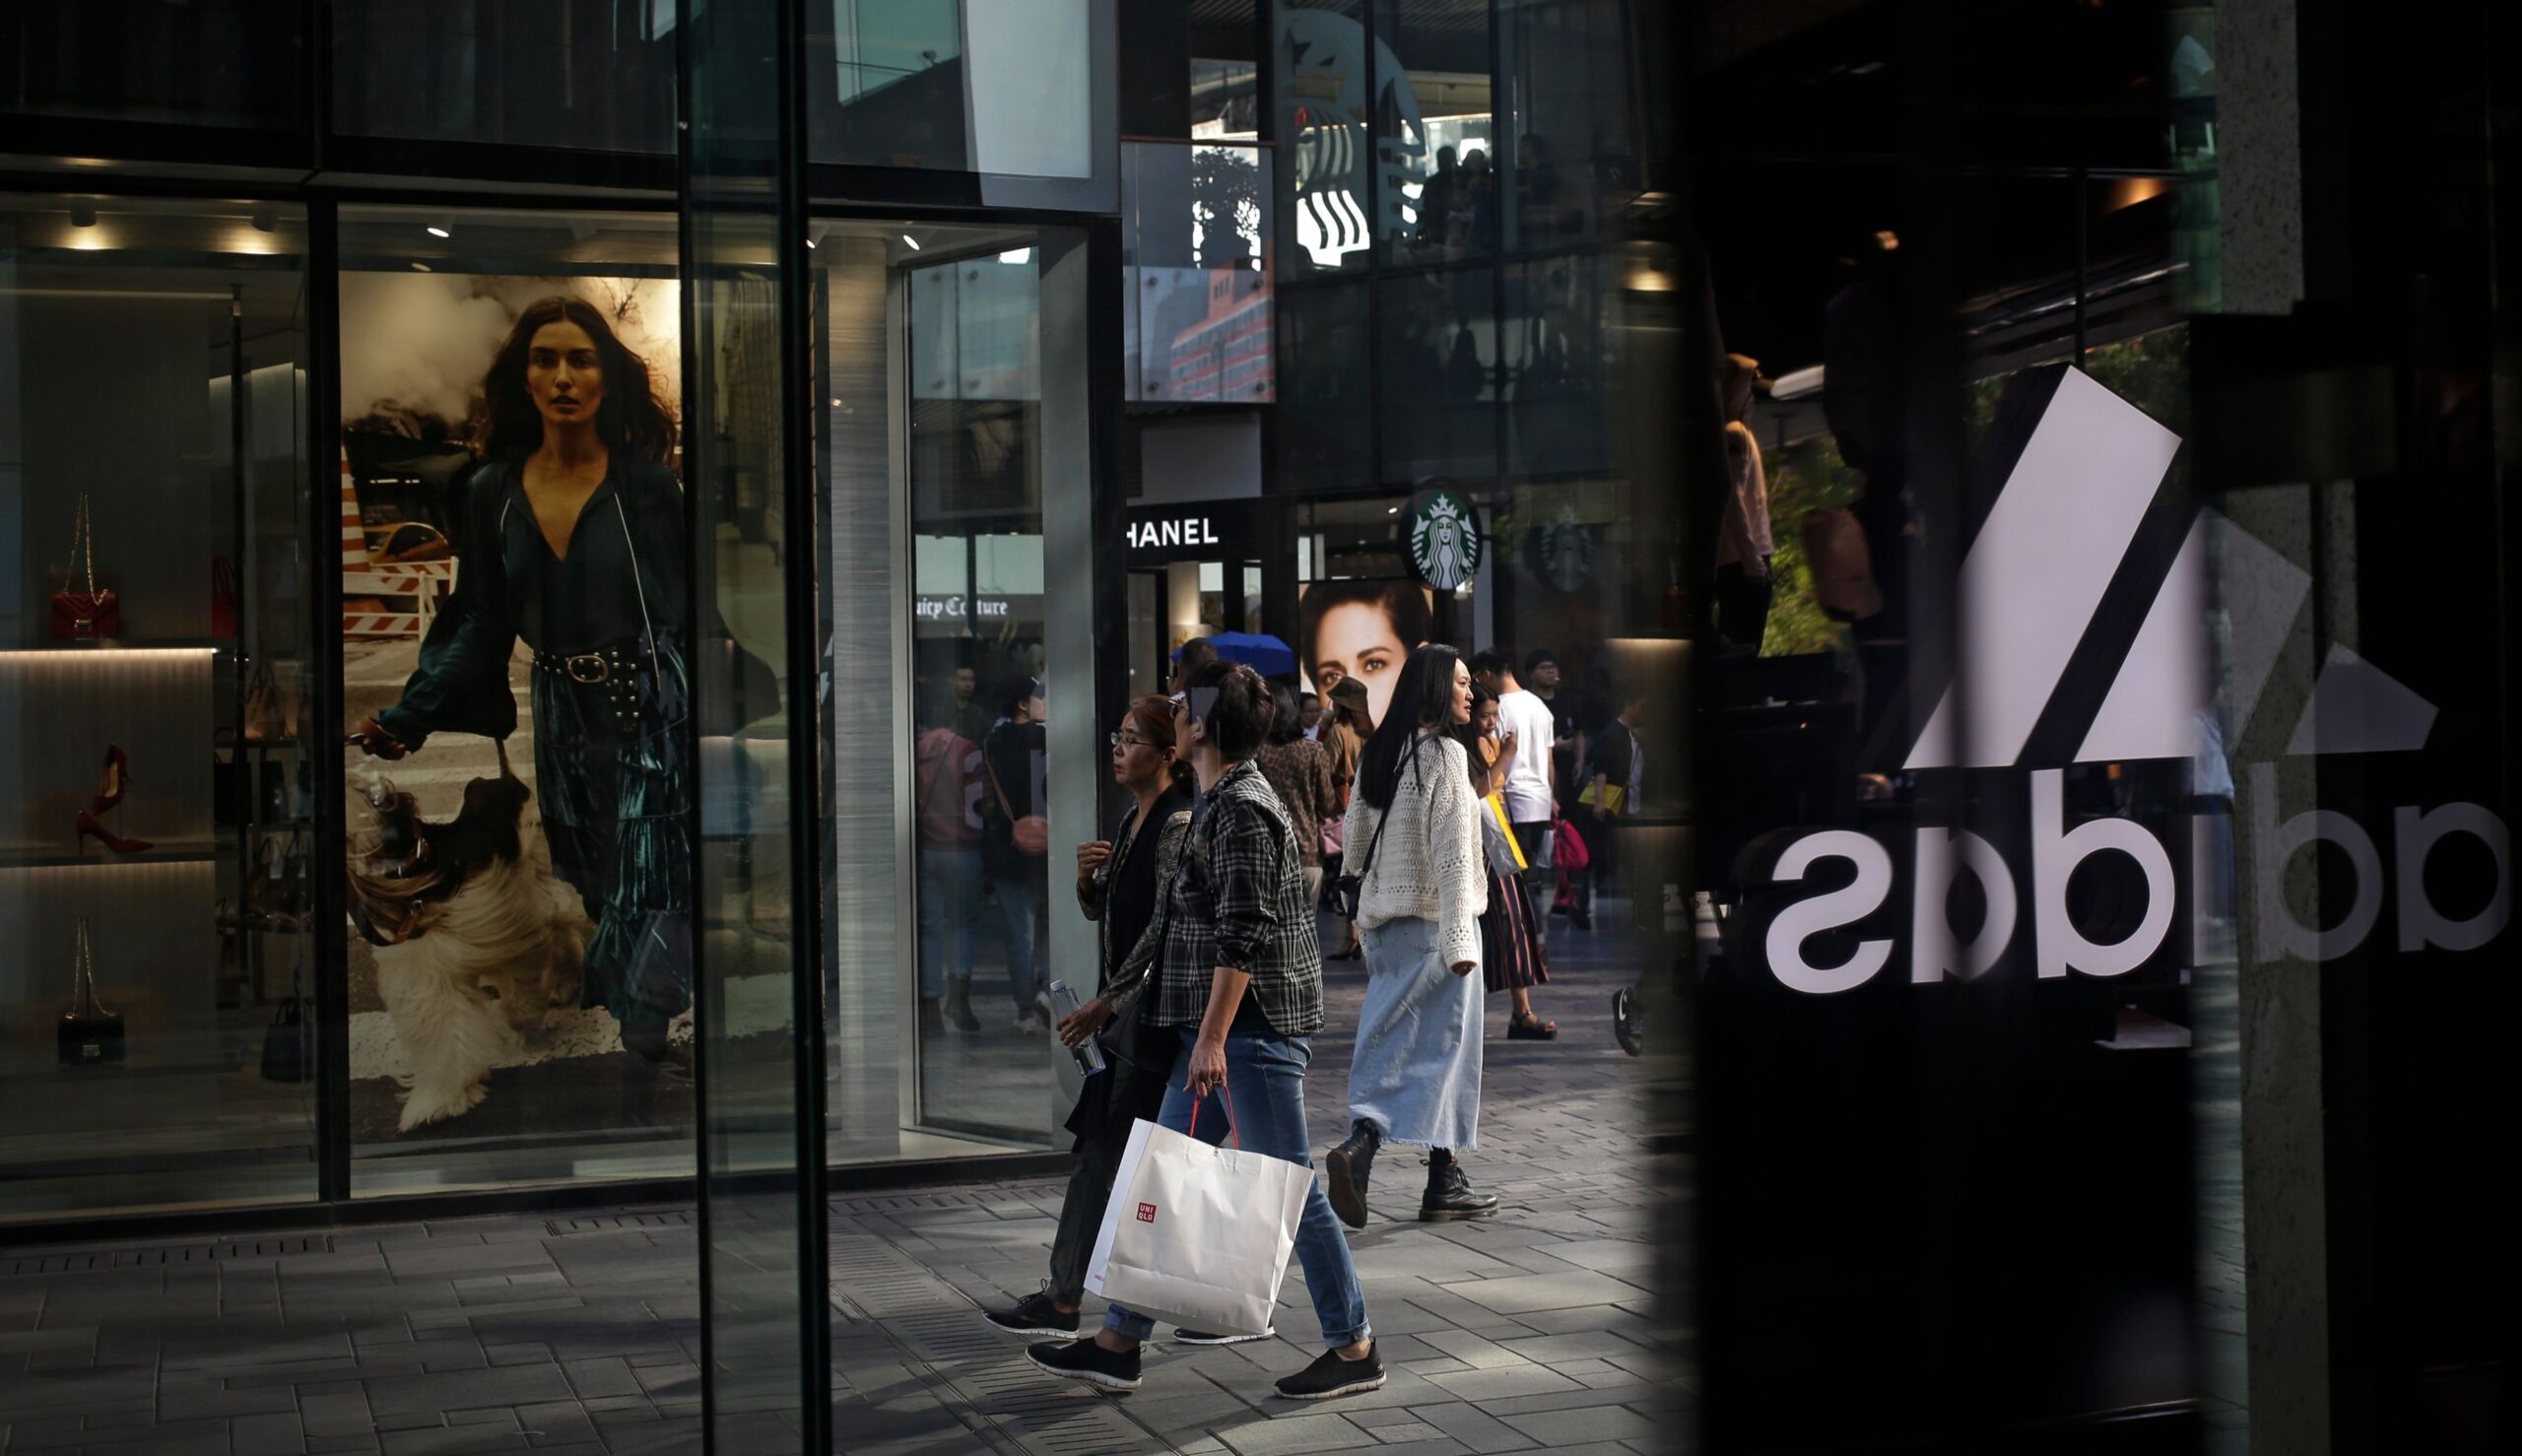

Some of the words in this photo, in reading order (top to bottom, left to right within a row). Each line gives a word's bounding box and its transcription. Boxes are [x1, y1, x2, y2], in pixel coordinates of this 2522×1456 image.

[946, 596, 1008, 617] Coture
[1140, 1205, 1155, 1214] UNI
[1138, 1212, 1154, 1222] QLO
